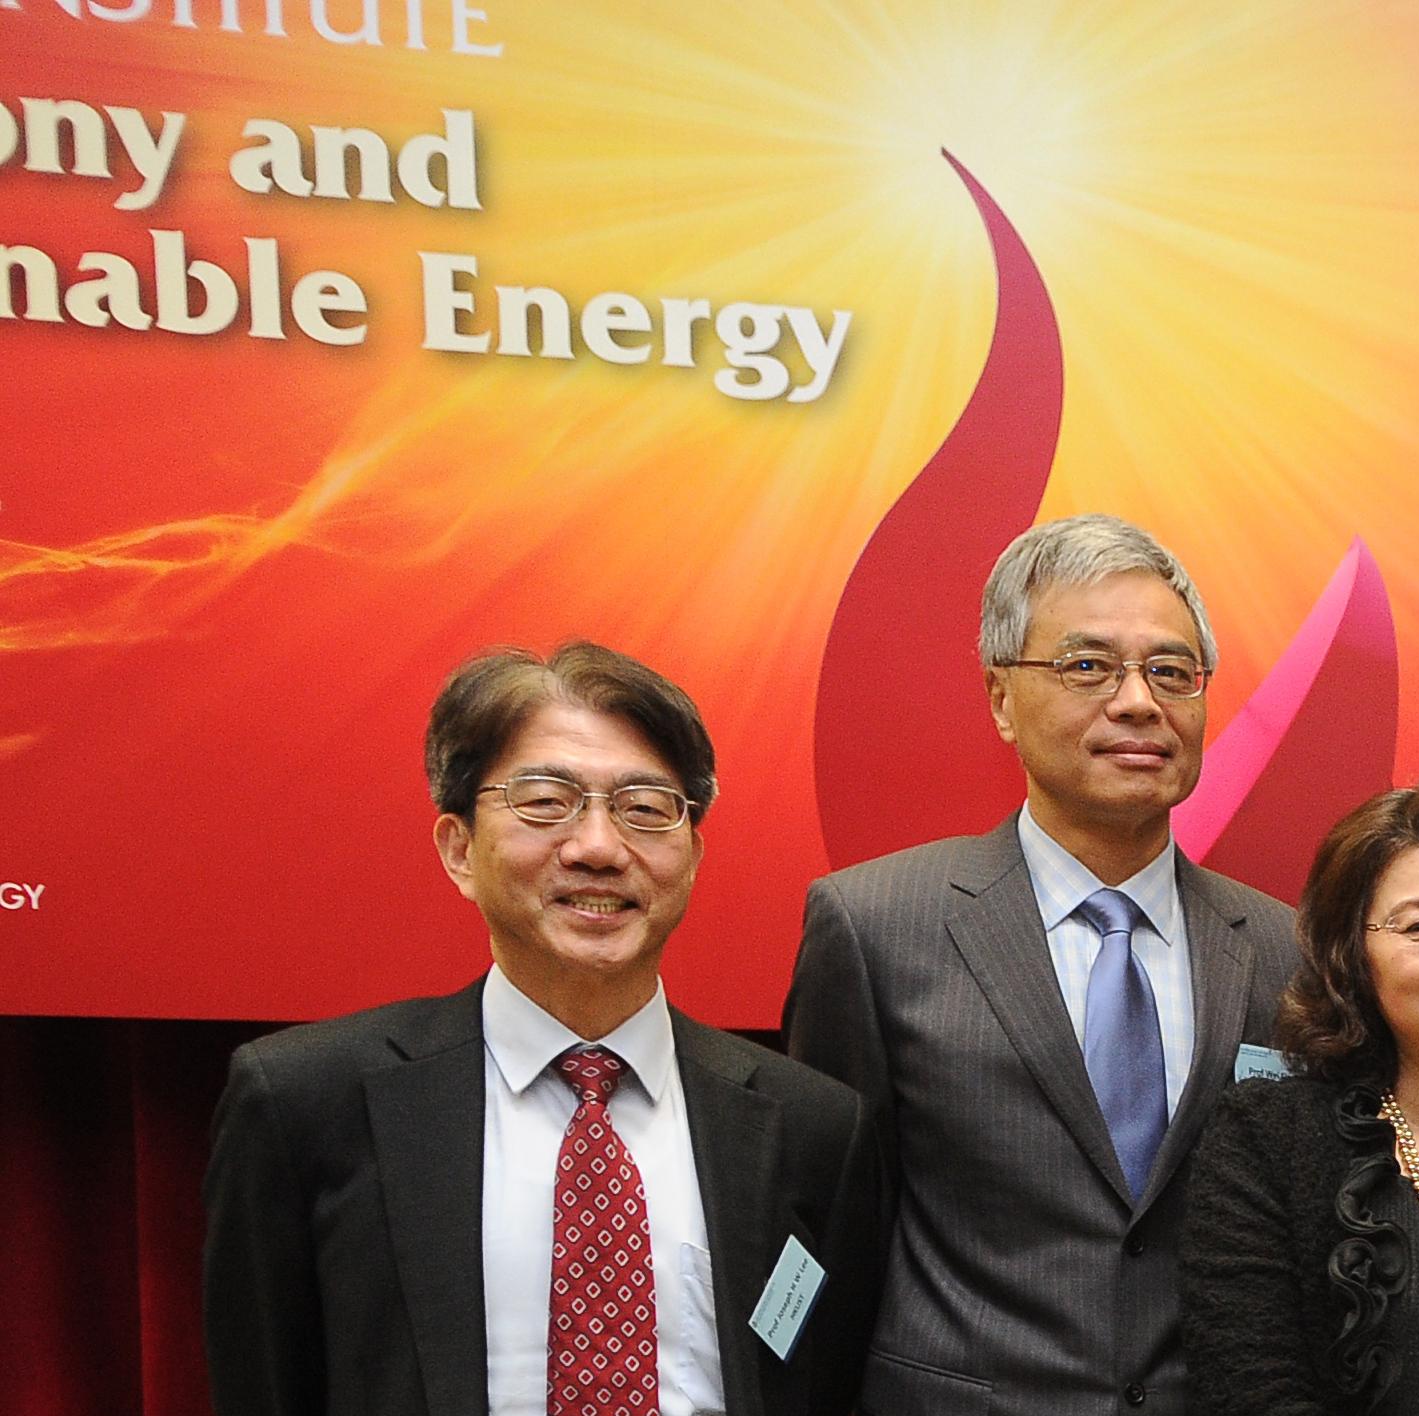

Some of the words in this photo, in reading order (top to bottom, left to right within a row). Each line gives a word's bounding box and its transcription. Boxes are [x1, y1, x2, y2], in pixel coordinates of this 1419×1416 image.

[0, 96, 188, 211] ny
[229, 109, 483, 211] and
[418, 251, 853, 403] Energy
[0, 882, 46, 910] GY
